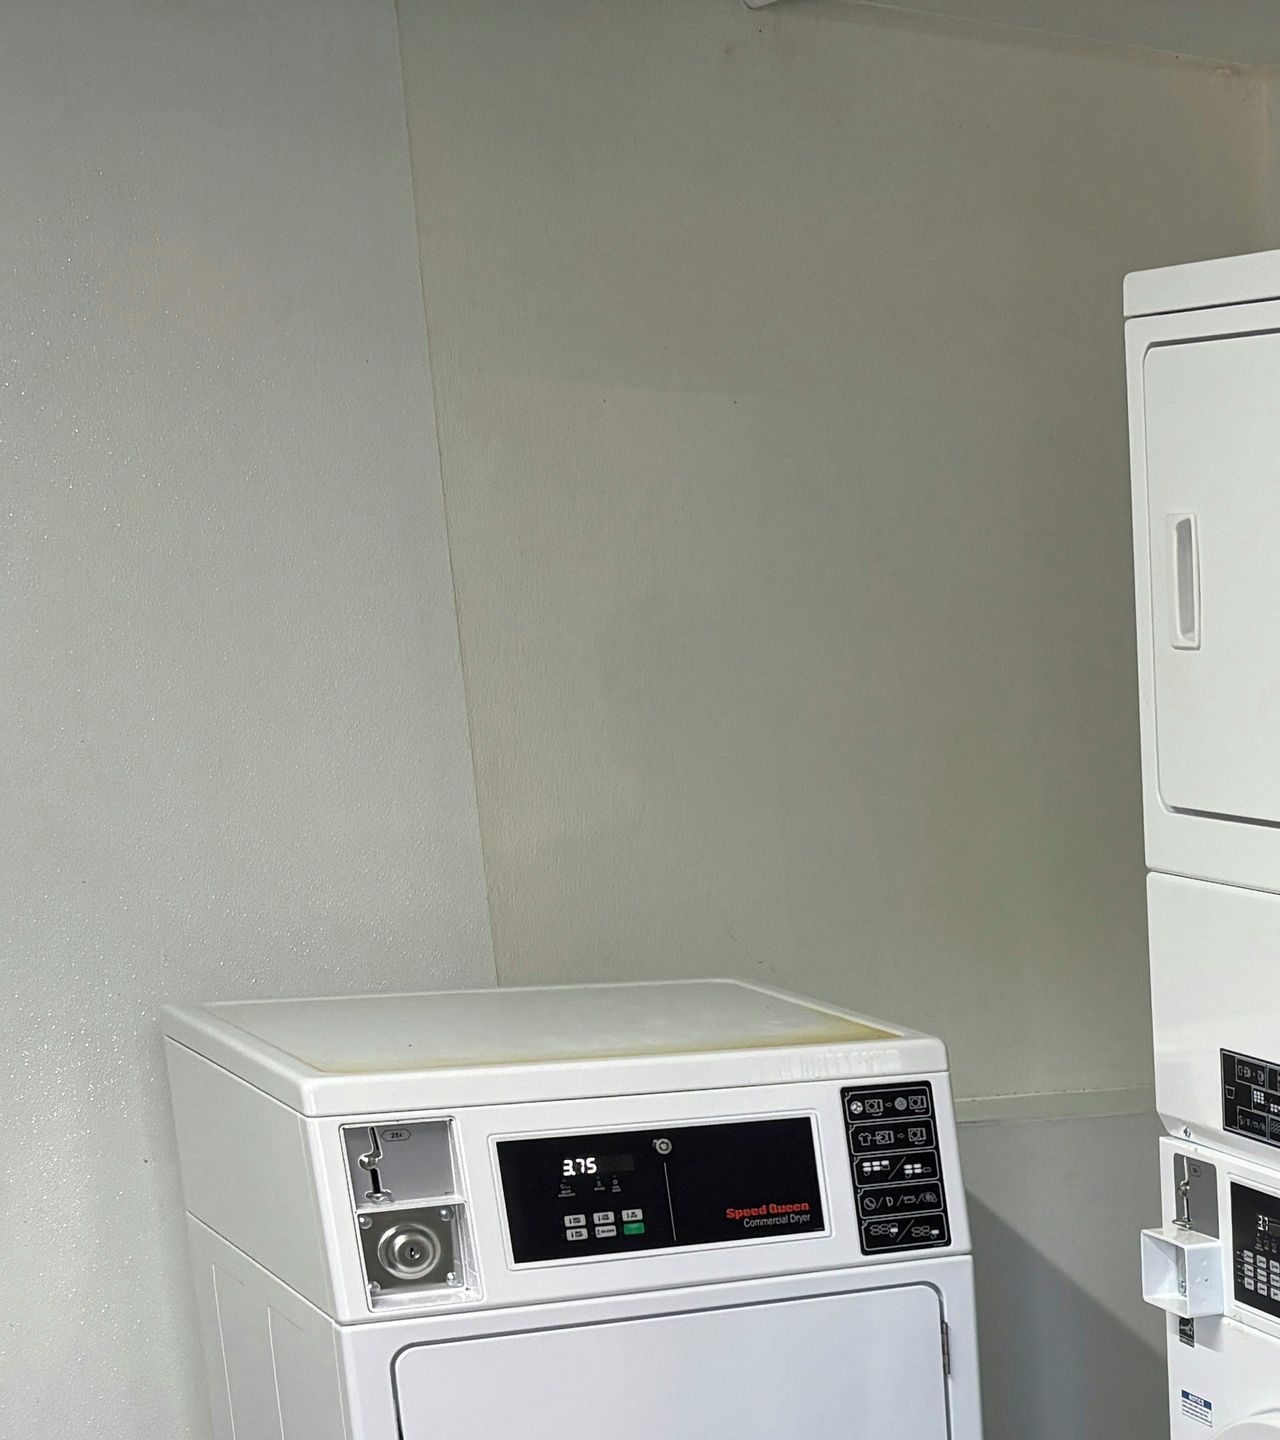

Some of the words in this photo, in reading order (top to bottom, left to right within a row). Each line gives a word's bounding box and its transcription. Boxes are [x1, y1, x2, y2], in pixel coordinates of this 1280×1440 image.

[726, 1204, 767, 1220] Speed
[768, 1203, 809, 1214] Queen
[744, 1215, 788, 1228] Commercial
[790, 1214, 810, 1224] Dryer
